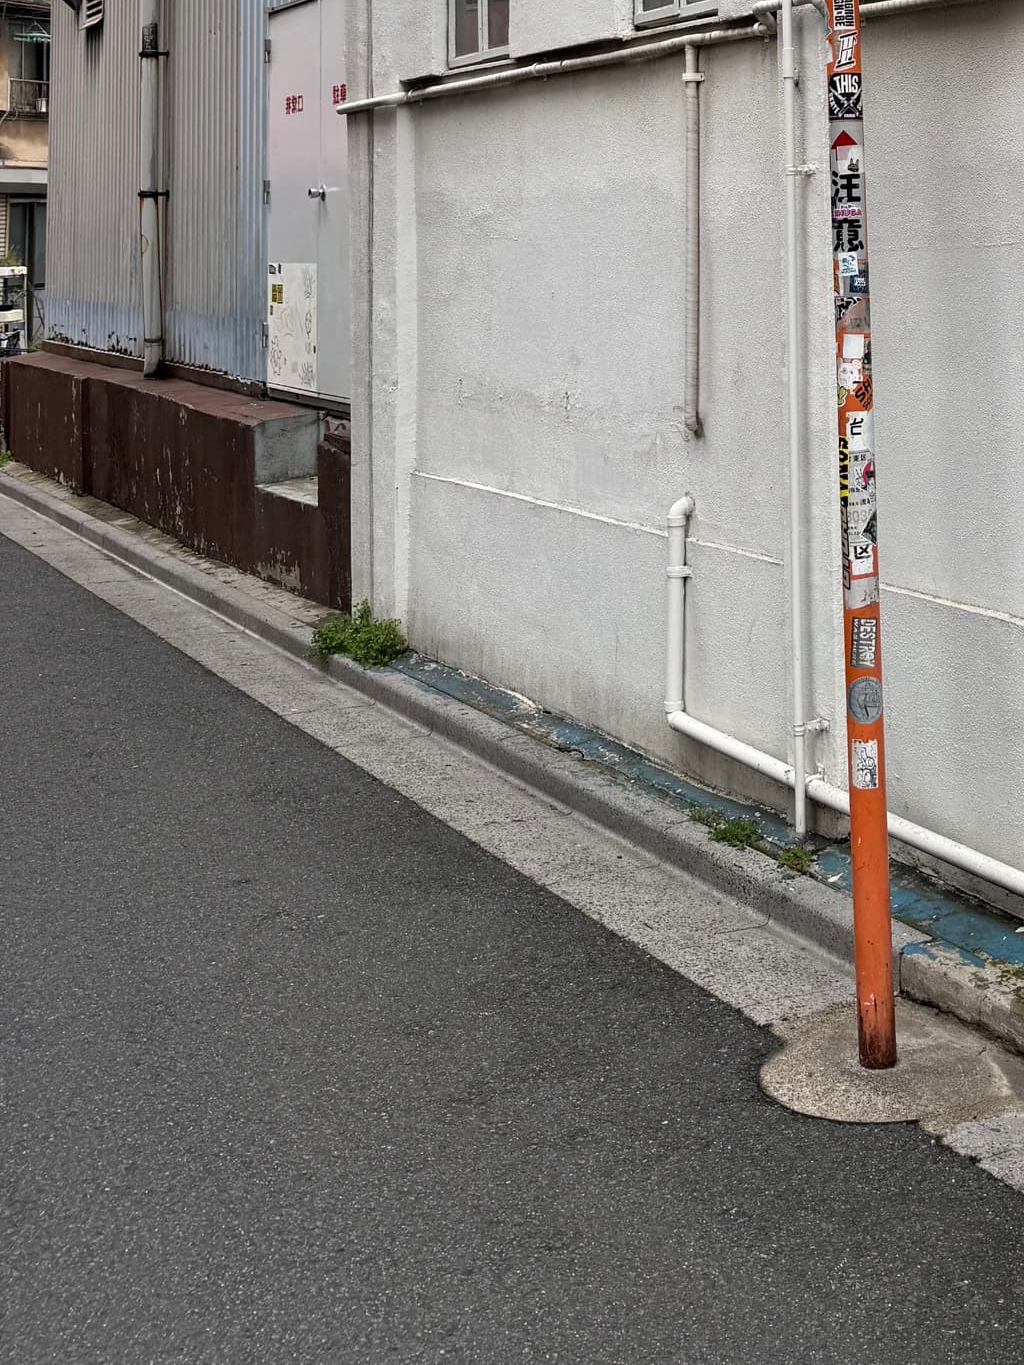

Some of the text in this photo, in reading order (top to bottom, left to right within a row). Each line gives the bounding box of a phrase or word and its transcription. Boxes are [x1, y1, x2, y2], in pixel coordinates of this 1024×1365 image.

[833, 74, 859, 94] THIS
[285, 95, 303, 114] 非常口
[832, 170, 865, 252] 注意
